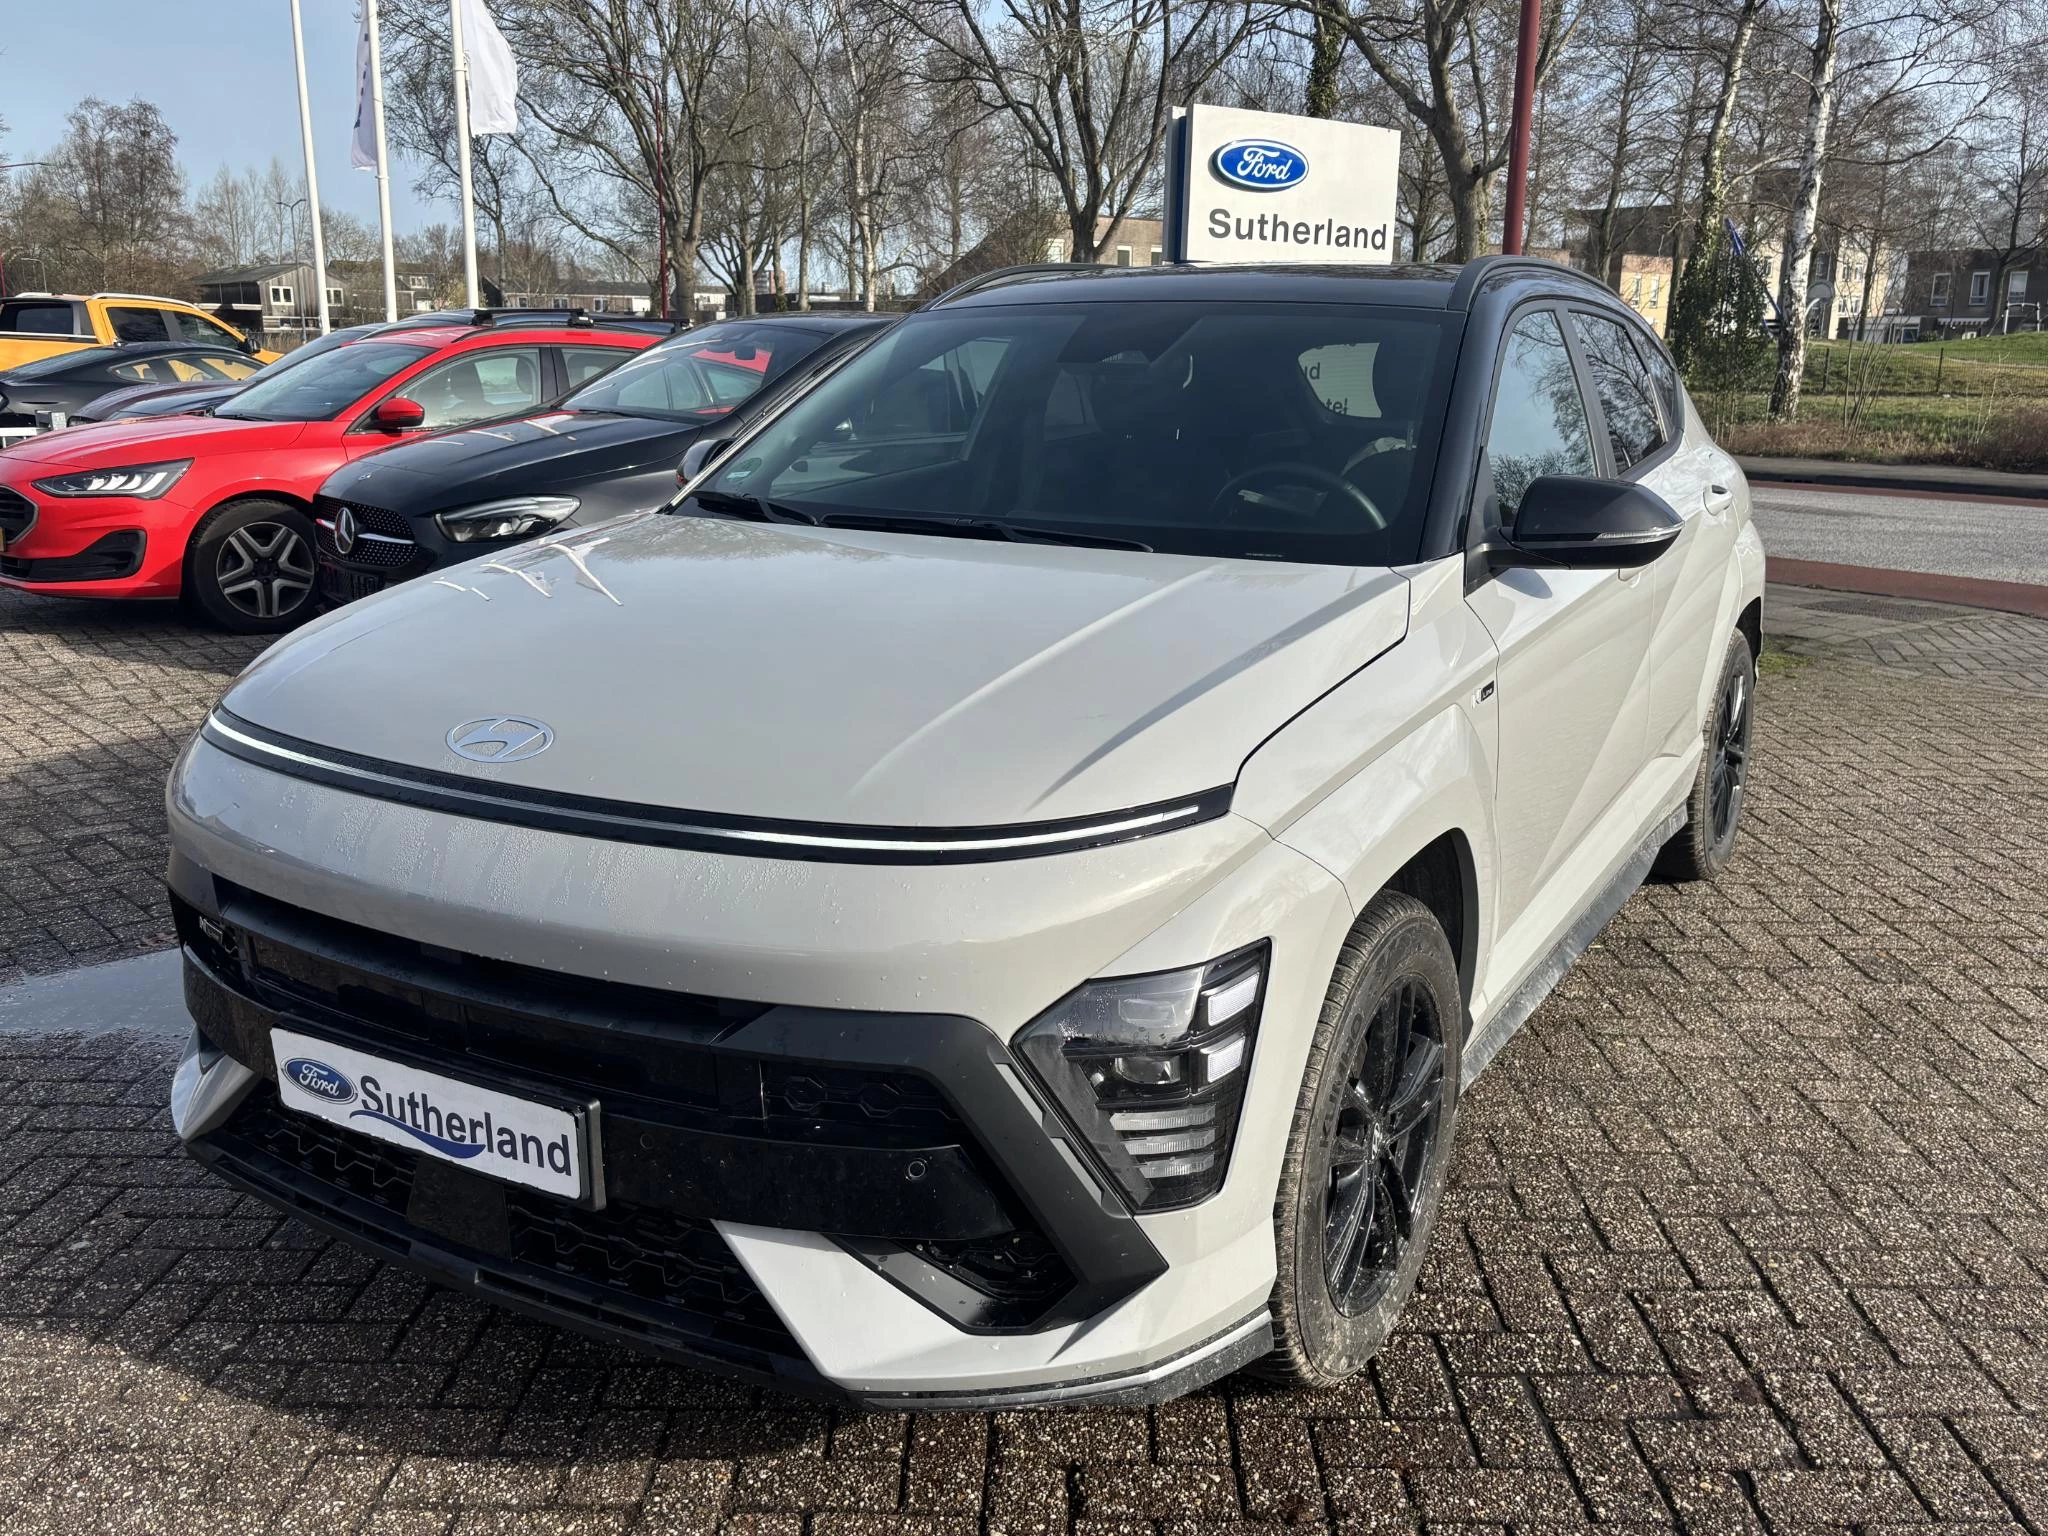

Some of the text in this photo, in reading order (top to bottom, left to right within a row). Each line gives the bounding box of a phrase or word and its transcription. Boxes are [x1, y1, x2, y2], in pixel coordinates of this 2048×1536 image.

[1236, 146, 1293, 181] Ford
[1208, 207, 1387, 251] Sutherland
[298, 1063, 572, 1177] Ford Sutherland
